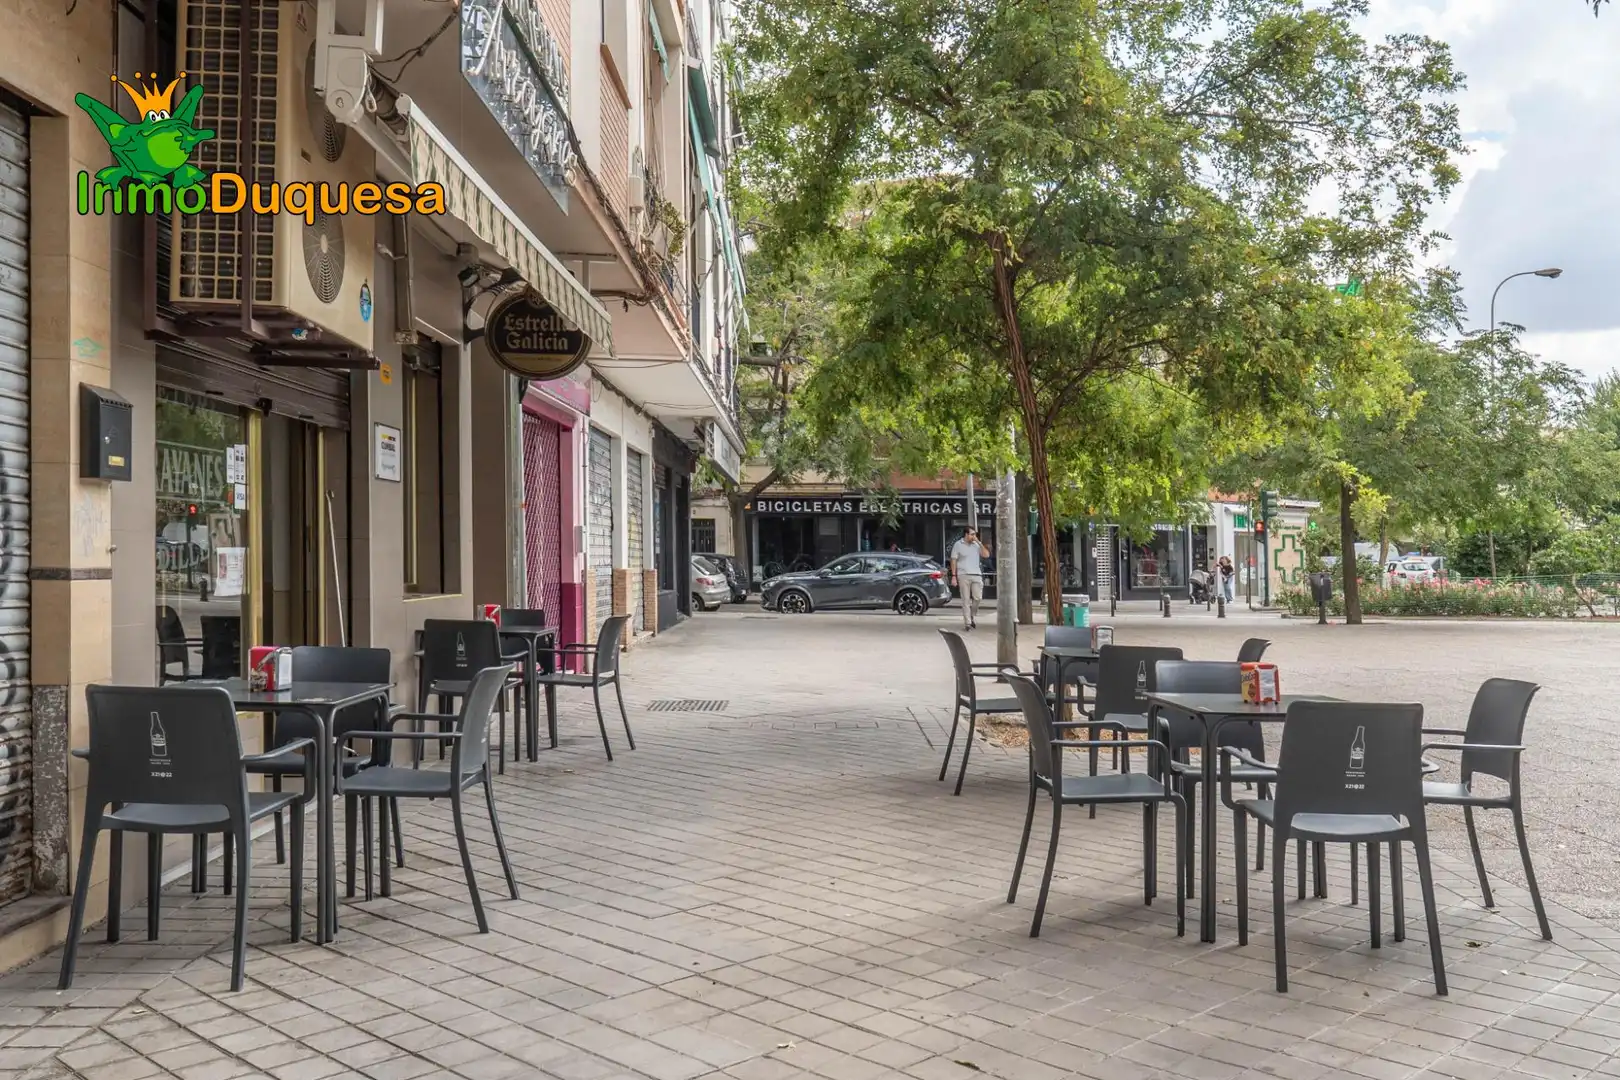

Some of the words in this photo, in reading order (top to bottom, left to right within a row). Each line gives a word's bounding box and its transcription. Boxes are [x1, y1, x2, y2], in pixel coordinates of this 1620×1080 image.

[503, 313, 567, 332] Estrell
[506, 331, 569, 350] Galicia
[757, 501, 853, 512] BICICLETAS
[859, 502, 963, 514] ELETRICAS
